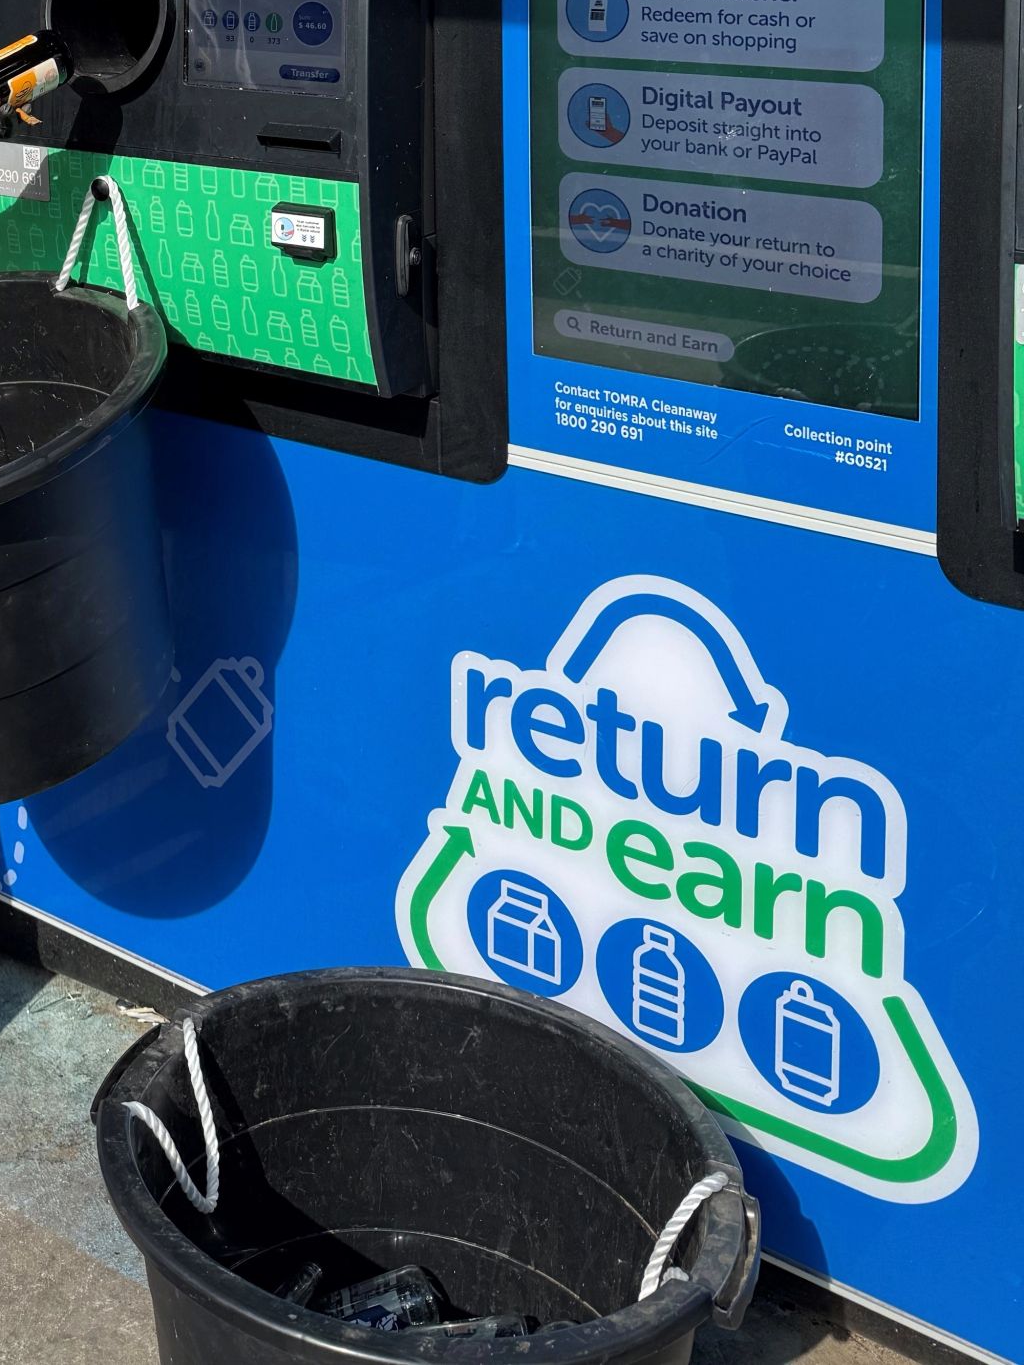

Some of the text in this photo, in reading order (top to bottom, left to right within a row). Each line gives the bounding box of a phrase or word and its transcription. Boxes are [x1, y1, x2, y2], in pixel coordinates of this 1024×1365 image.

[640, 6, 816, 28] Redeem for cash or
[640, 30, 797, 53] save on shopping
[290, 68, 329, 80] Transfer
[641, 86, 803, 118] Digital Payout
[642, 114, 822, 143] Deposit straight into
[640, 137, 818, 166] your bank or PayPal
[22, 172, 43, 187] 691
[642, 193, 747, 224] Donation
[642, 220, 836, 258] Donate your return to
[642, 244, 852, 282] a charity of your choice
[590, 320, 719, 353] Return and Earn
[554, 381, 718, 425] Contact TOMRA Cleanaway
[554, 397, 718, 440] for enquiries about this site
[555, 412, 644, 442] 1800 290 691
[784, 423, 893, 455] Collection point
[835, 450, 887, 472] #G0521
[465, 667, 887, 880] return
[461, 769, 885, 979] AND earn
